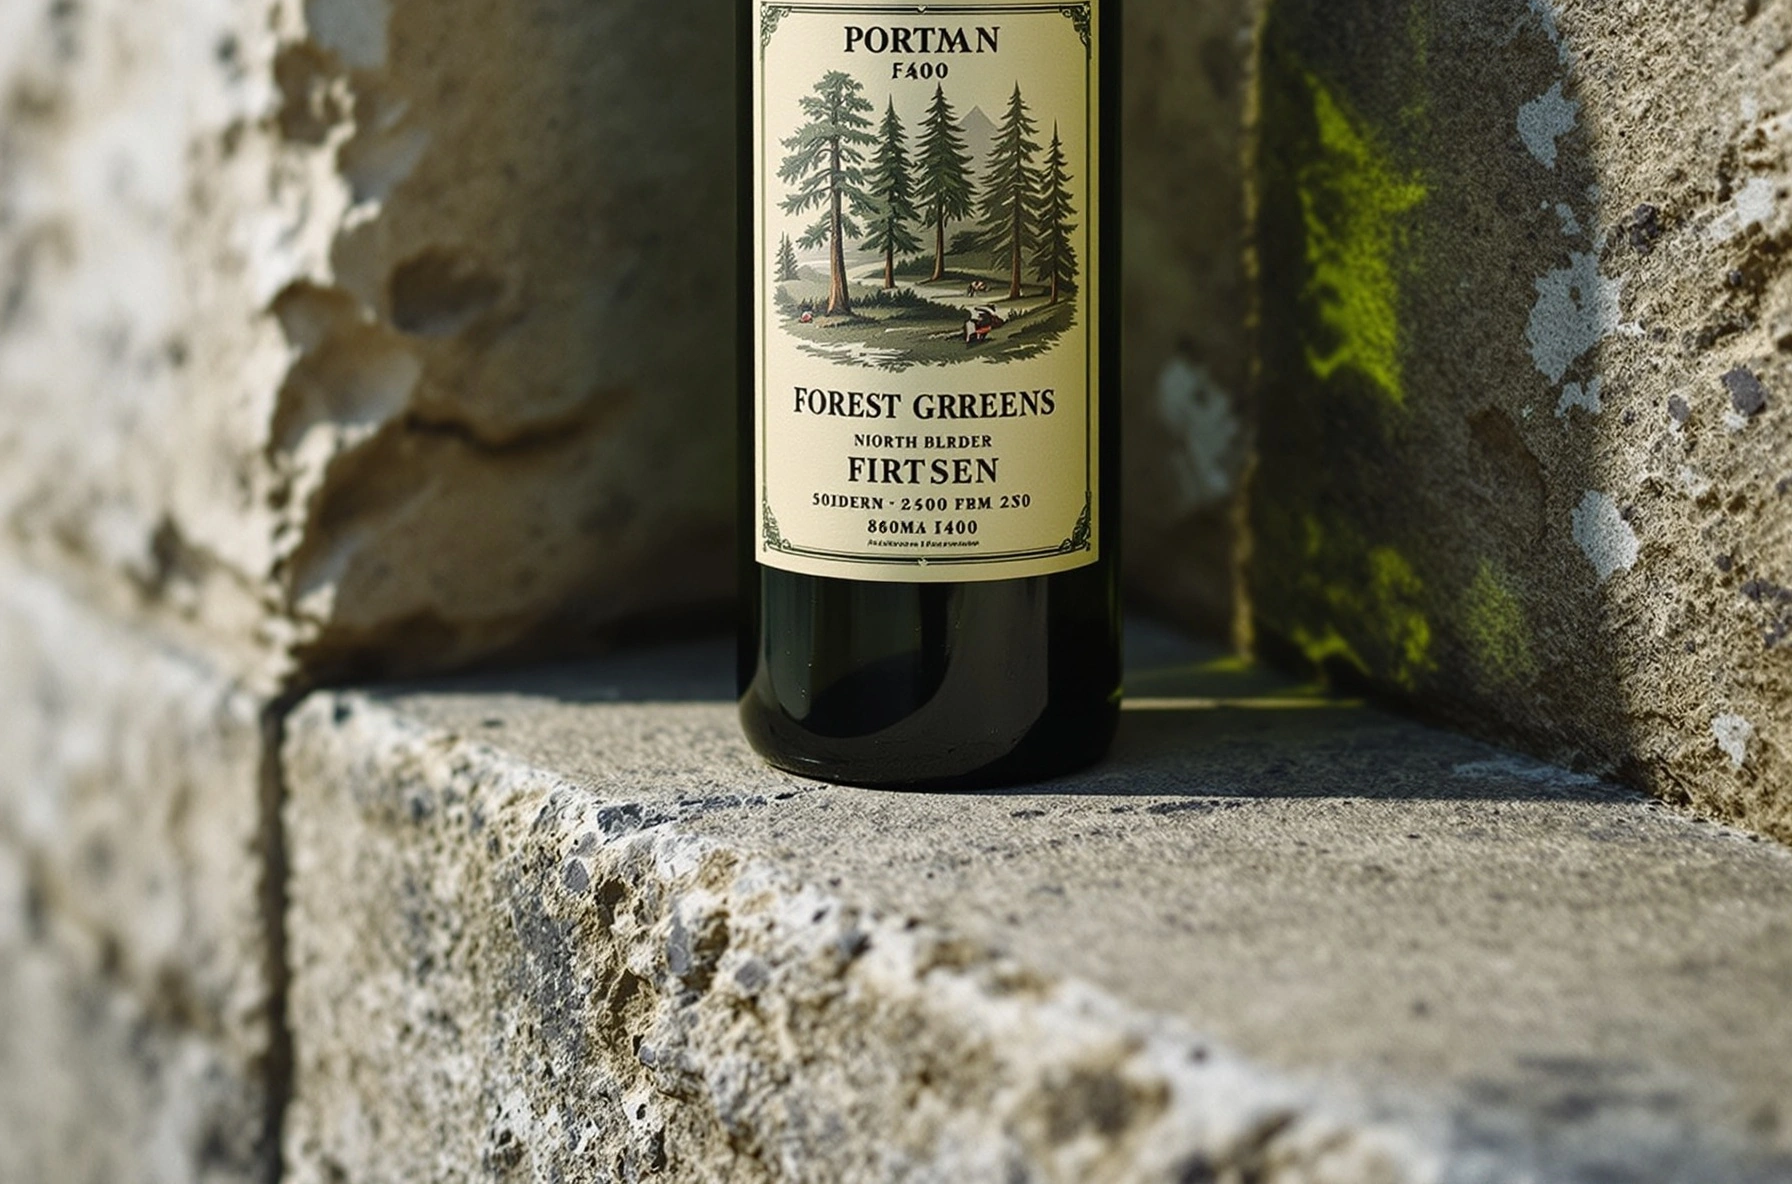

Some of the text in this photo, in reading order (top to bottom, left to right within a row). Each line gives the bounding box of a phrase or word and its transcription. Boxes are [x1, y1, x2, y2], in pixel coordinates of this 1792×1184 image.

[794, 386, 1055, 419] FOREST GRREENS
[848, 456, 999, 484] FIRTSEN
